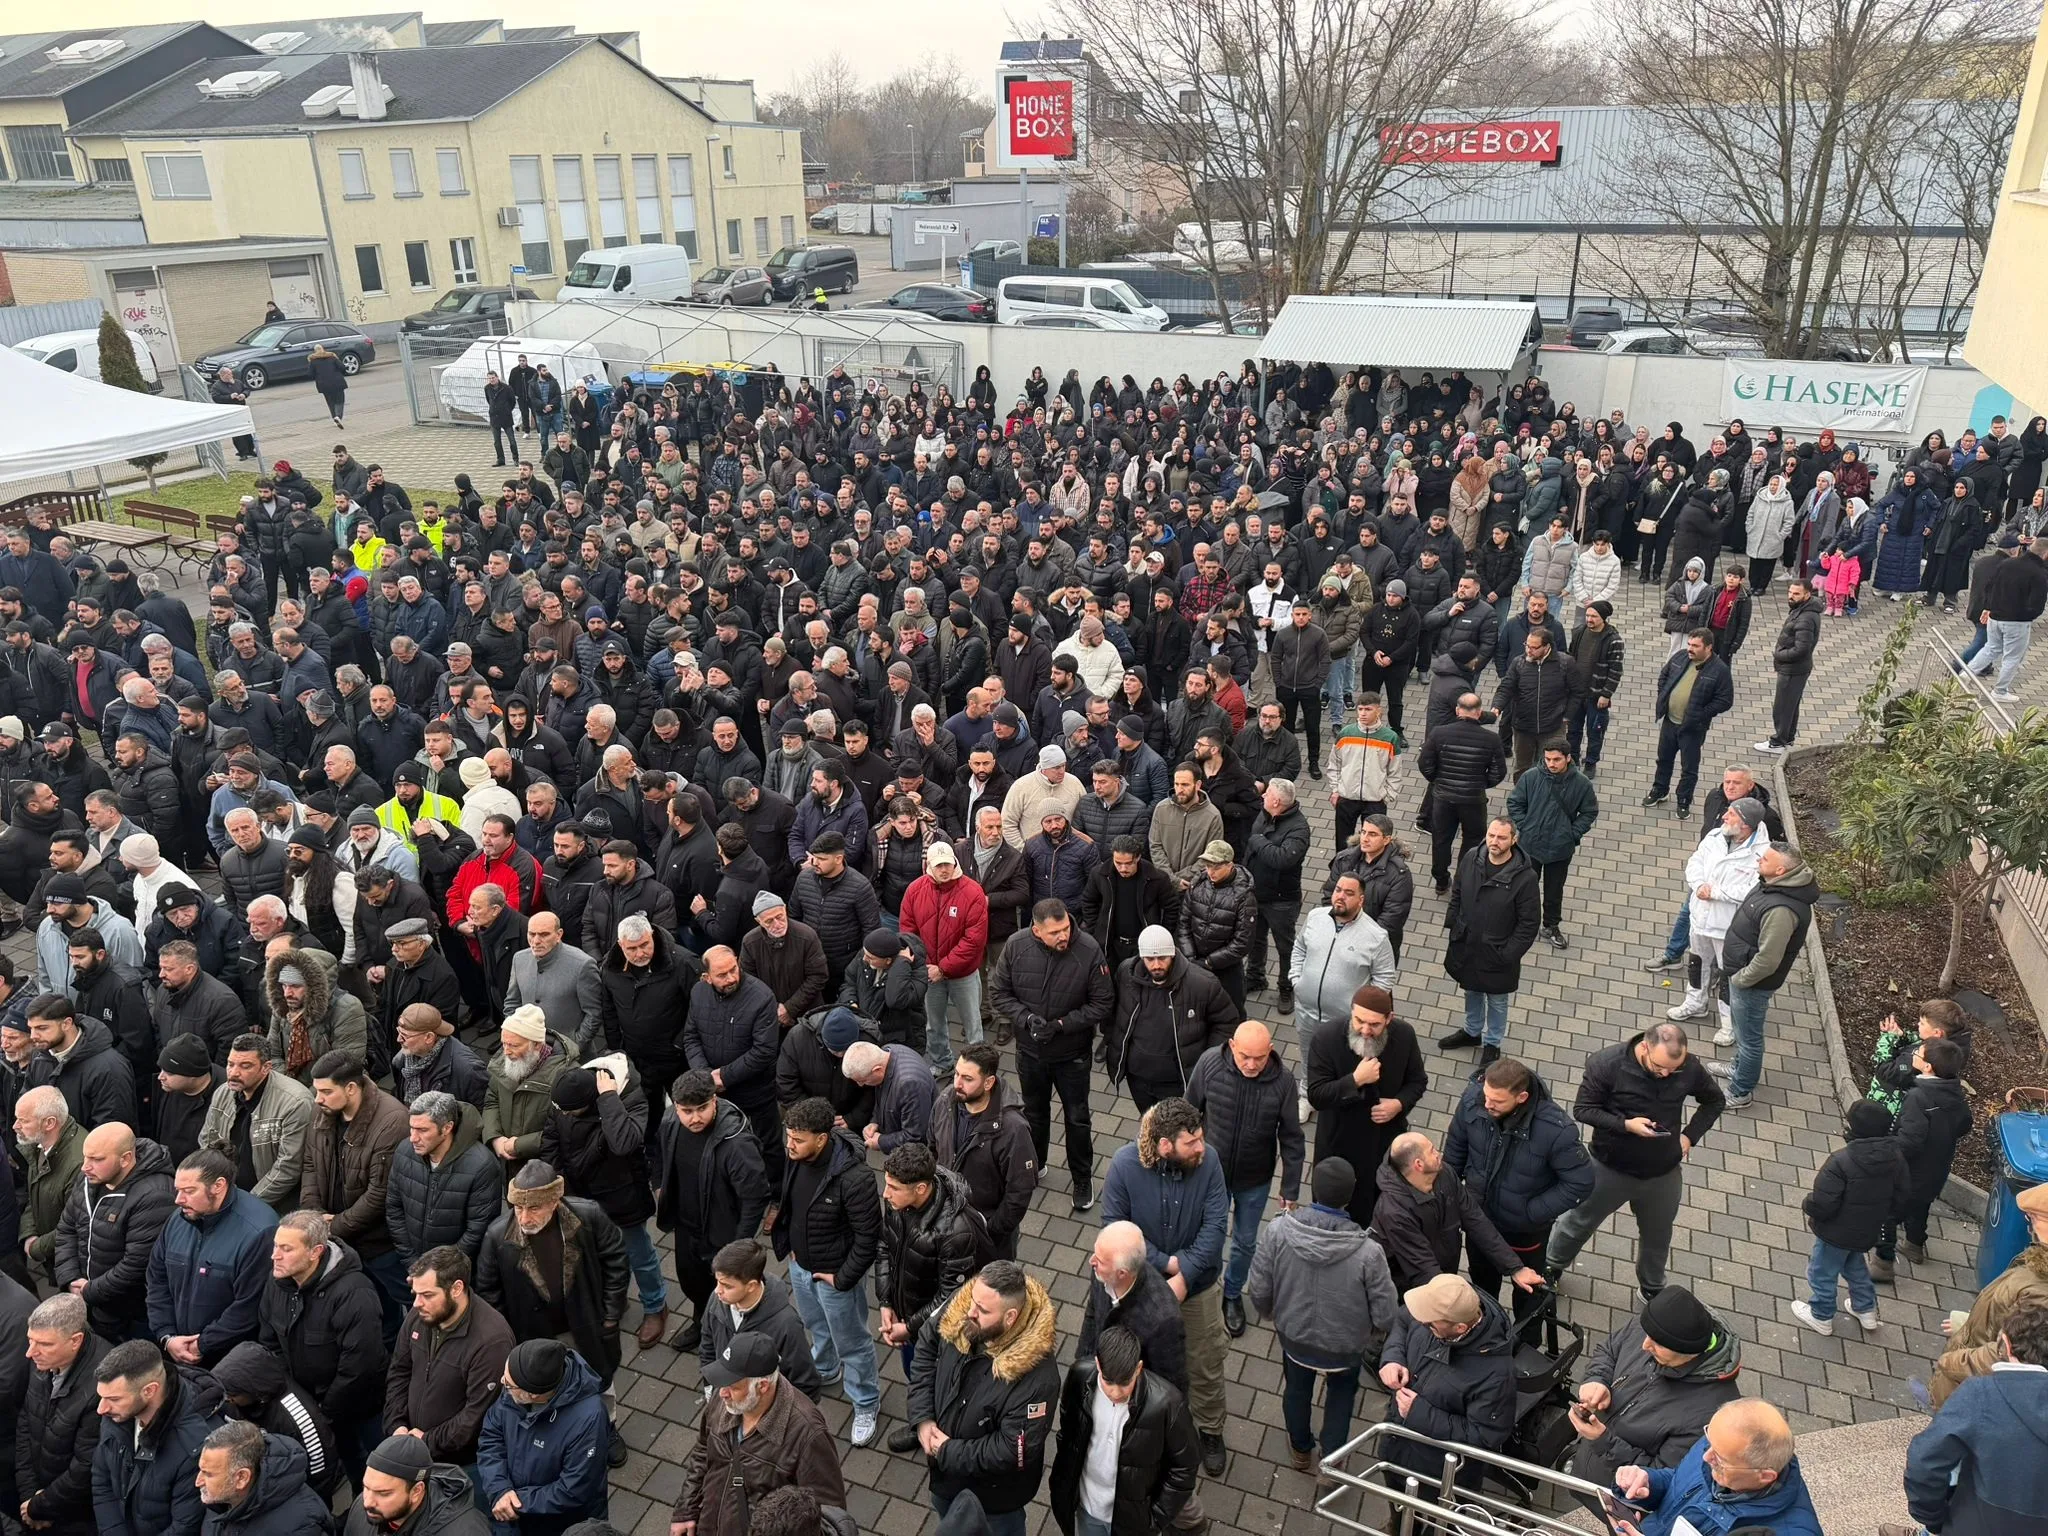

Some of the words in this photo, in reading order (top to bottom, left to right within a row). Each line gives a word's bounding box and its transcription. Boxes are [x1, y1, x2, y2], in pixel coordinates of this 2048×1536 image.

[1016, 95, 1065, 116] HOME
[1016, 118, 1066, 138] BOX
[1764, 374, 1910, 408] HASENE
[1843, 407, 1905, 419] International
